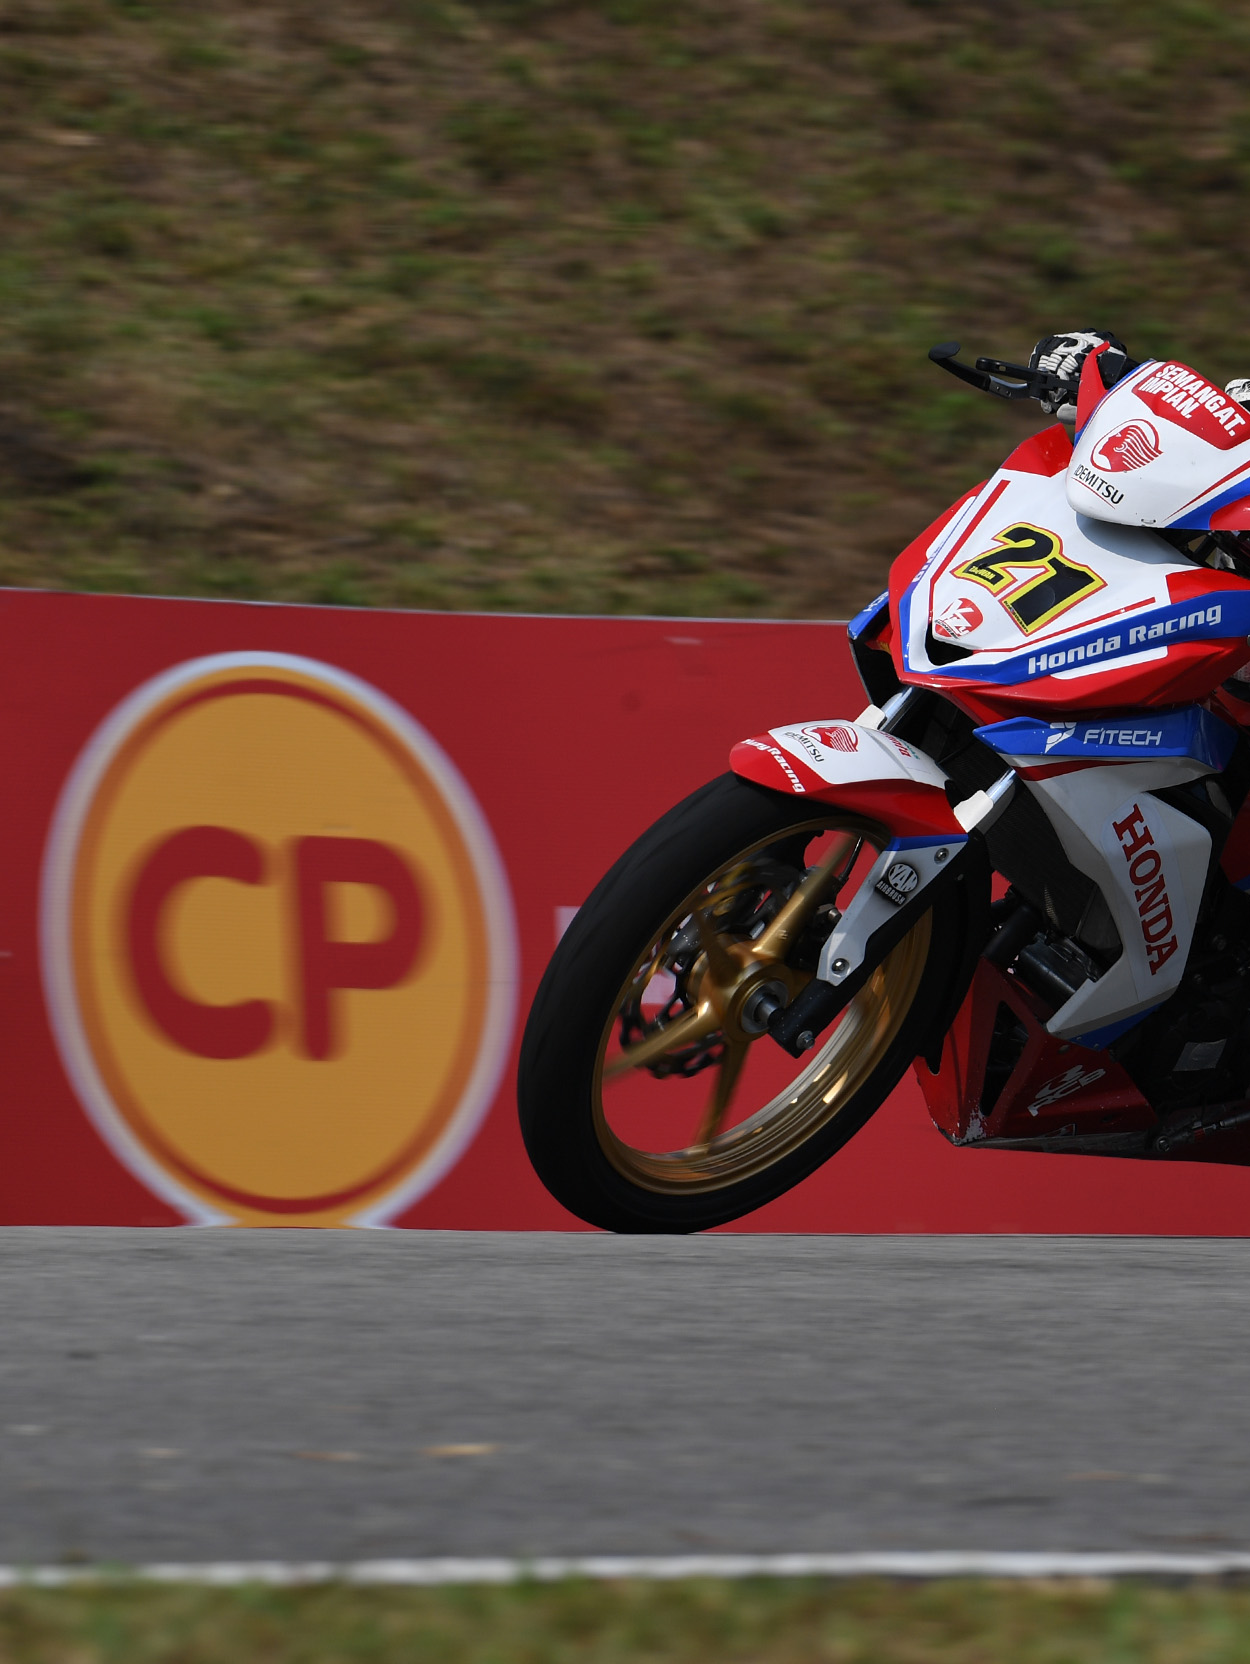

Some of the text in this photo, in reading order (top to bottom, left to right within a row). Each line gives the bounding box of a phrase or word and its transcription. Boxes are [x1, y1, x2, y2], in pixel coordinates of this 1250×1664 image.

[1073, 463, 1125, 506] IDEMITSU
[952, 523, 1107, 636] 21
[1028, 604, 1222, 675] Honda Racing
[767, 744, 806, 793] Racing
[1112, 804, 1178, 975] HONDA
[118, 825, 438, 1061] CP
